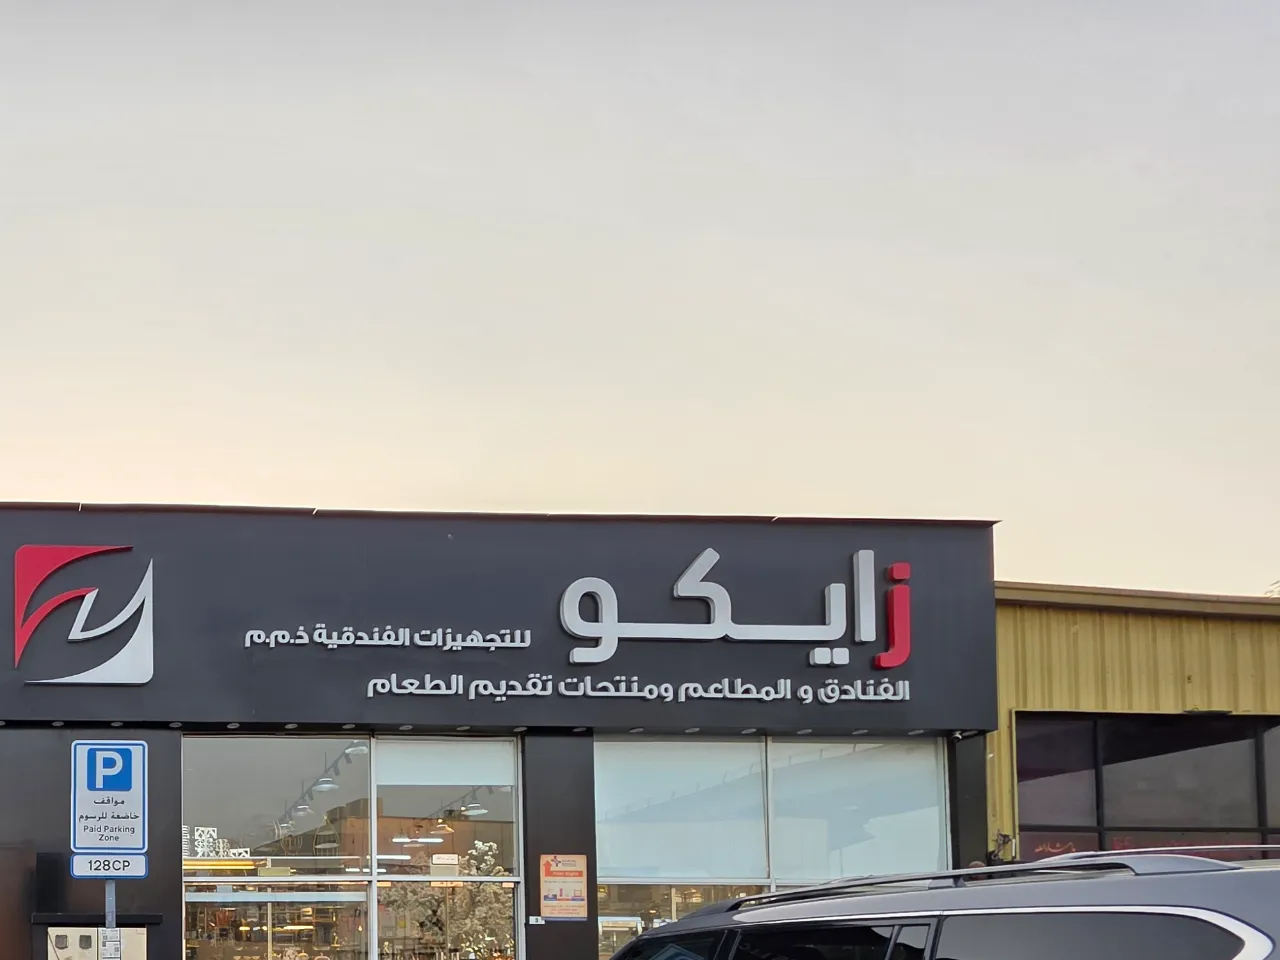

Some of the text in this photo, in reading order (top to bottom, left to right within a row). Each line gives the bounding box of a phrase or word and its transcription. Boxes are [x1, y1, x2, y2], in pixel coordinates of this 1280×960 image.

[559, 547, 912, 669] زايكو
[312, 623, 411, 649] الفندقية
[413, 628, 532, 651] للتجهيزات
[367, 673, 464, 698] الطعام
[468, 673, 553, 702] تقديم
[678, 677, 792, 702] المطاعم
[797, 685, 814, 704] و
[817, 677, 911, 704] الفنادق
[95, 750, 123, 789] P
[83, 825, 135, 834] Paid Parking
[98, 834, 120, 842] Zone
[88, 859, 131, 872] 128CP
